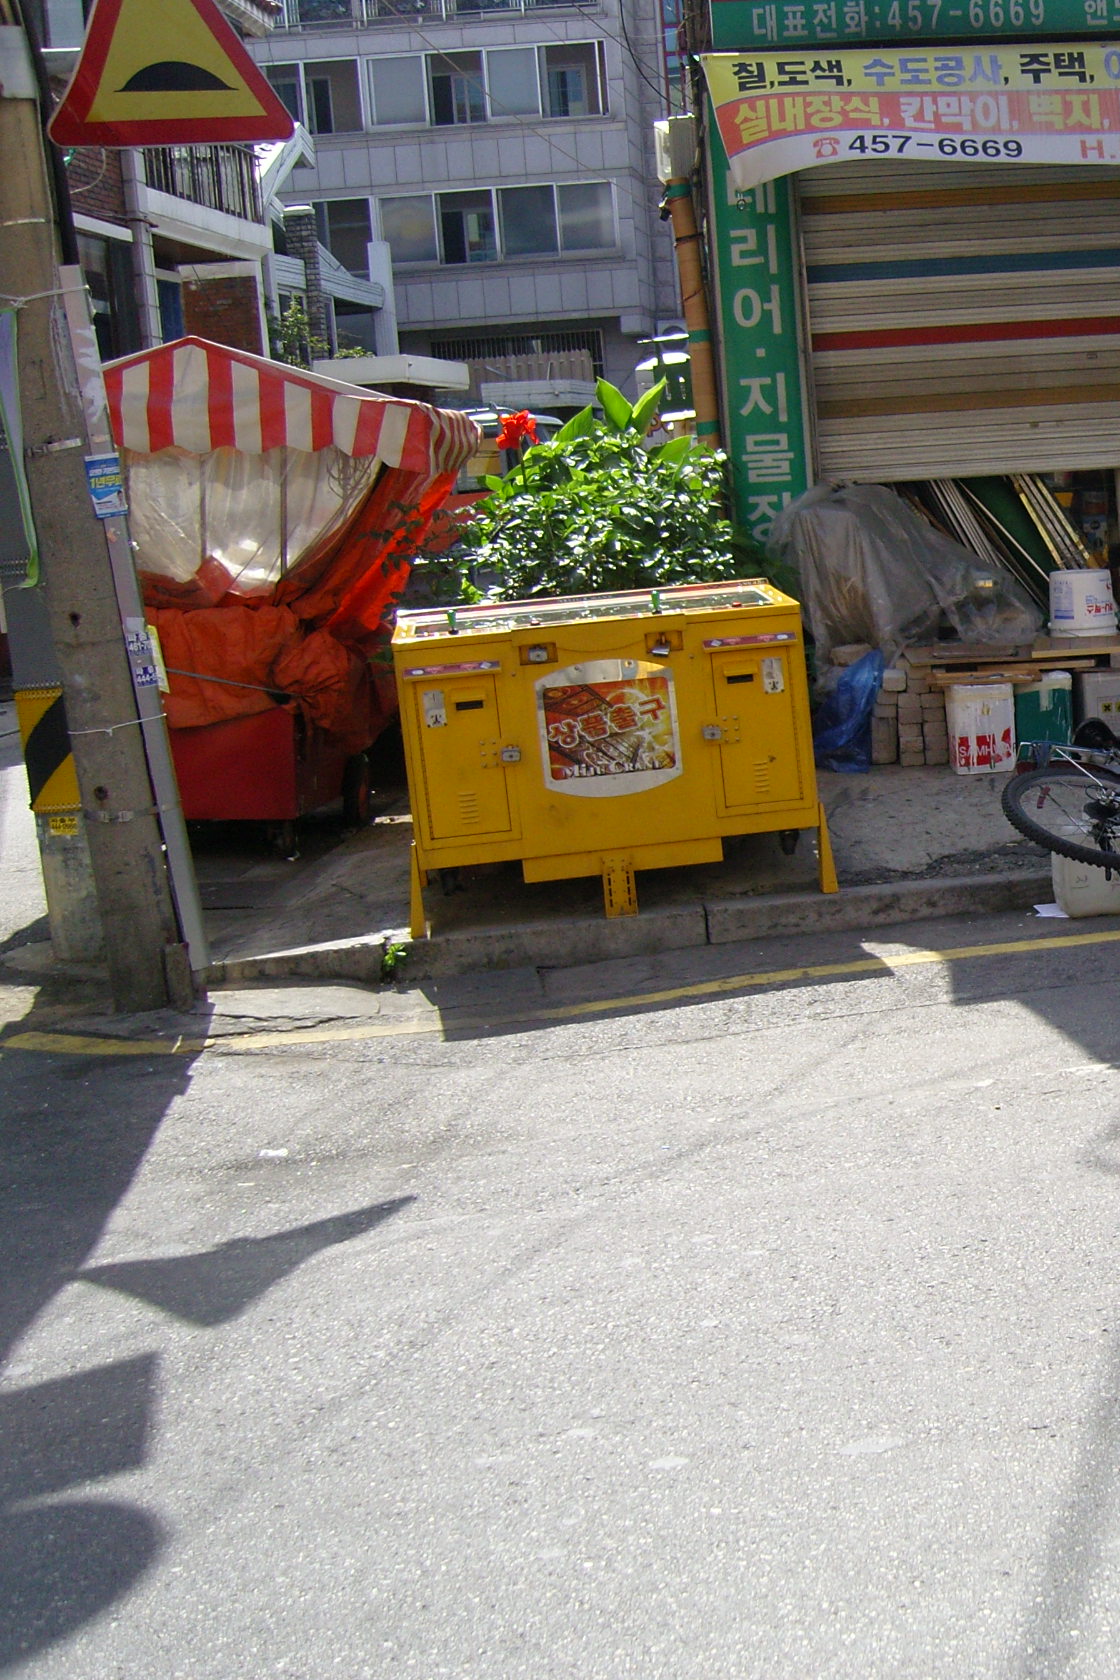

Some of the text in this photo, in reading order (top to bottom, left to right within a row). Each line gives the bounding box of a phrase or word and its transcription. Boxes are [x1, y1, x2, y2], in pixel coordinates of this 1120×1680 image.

[863, 55, 1009, 88] 수도공사,
[1019, 52, 1095, 84] 주택,
[734, 95, 890, 145] 실내장식,
[900, 96, 1020, 131] 칸막이,
[1029, 95, 1110, 130] 벽지,
[848, 134, 1023, 159] 457-6669
[546, 694, 667, 749] 상품출구
